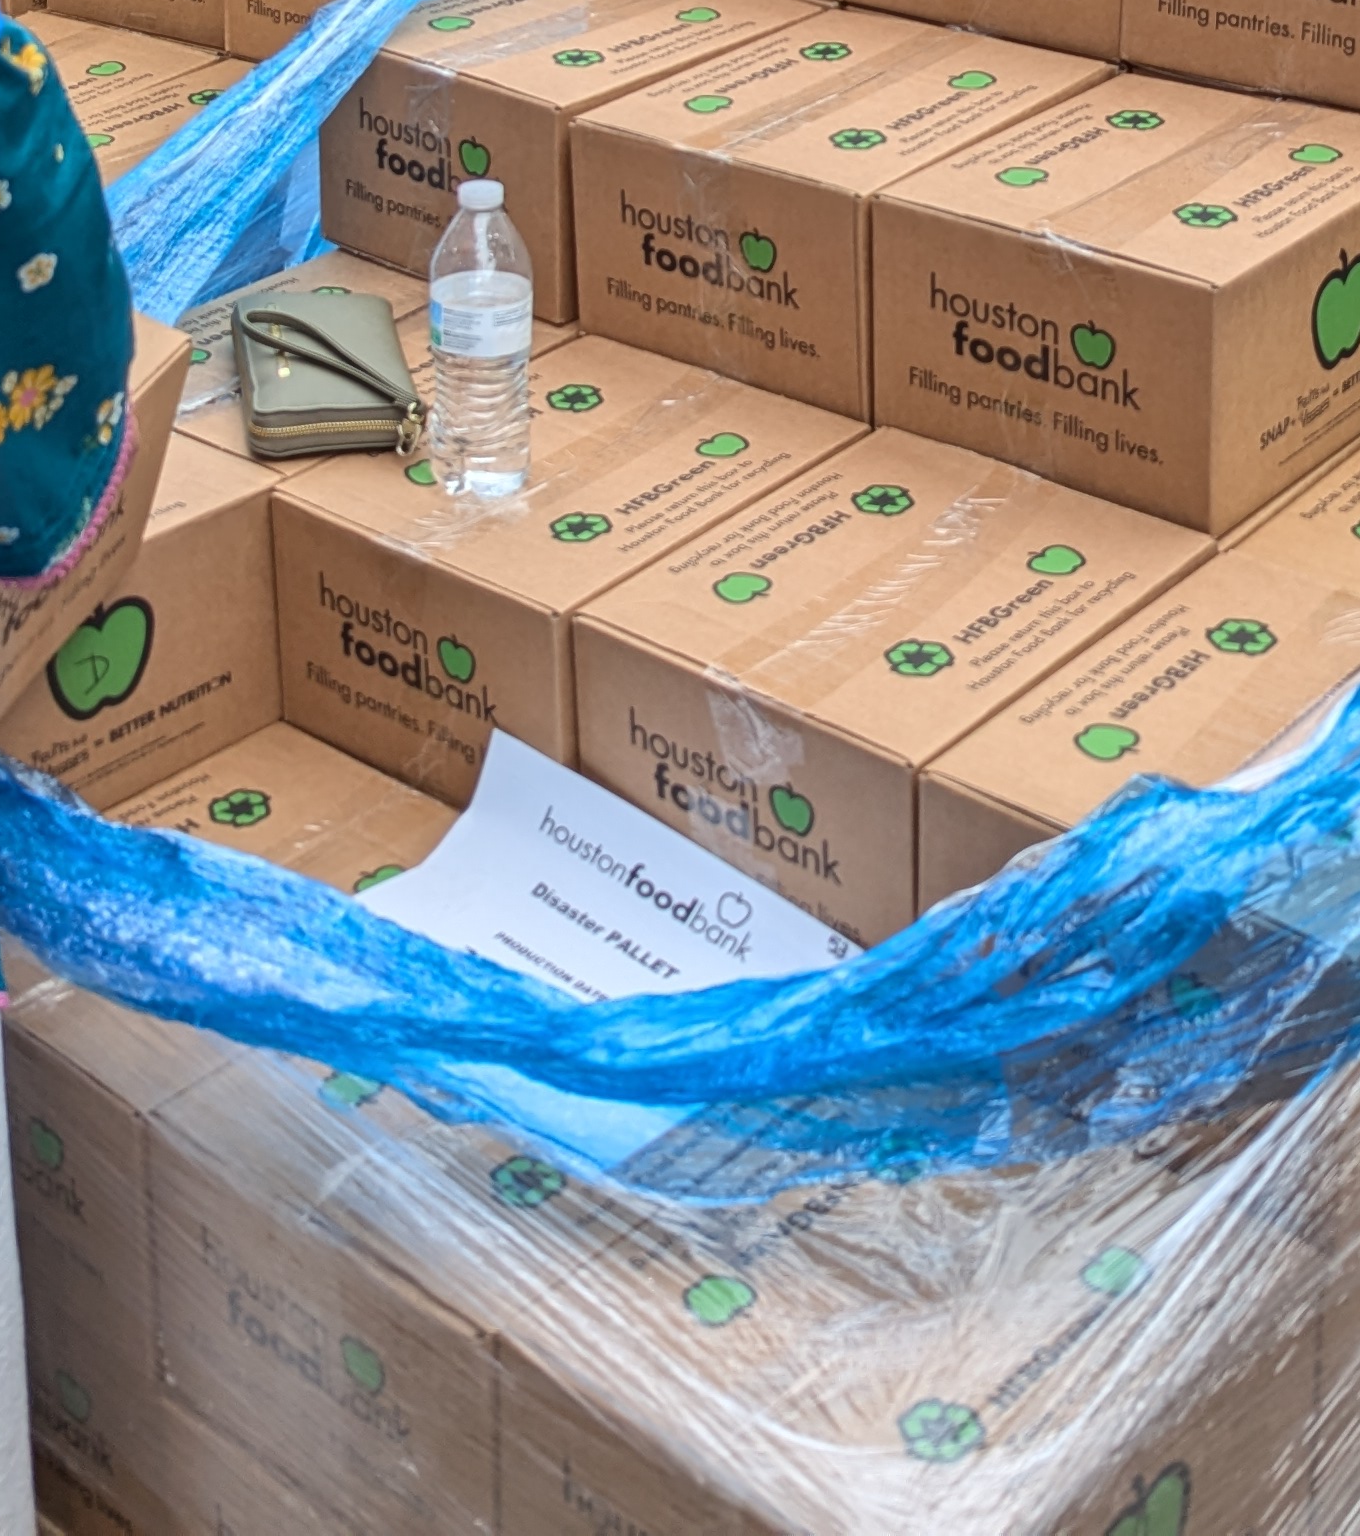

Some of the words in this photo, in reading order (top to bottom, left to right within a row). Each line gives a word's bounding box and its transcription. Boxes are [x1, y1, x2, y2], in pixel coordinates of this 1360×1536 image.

[1215, 11, 1295, 39] pantries.
[1301, 20, 1356, 57] Filling
[359, 97, 452, 159] houston
[345, 178, 383, 213] Filling
[376, 138, 461, 194] foodb
[620, 188, 730, 253] houston
[641, 232, 800, 311] foodbank
[607, 276, 652, 313] Filling
[656, 297, 724, 330] pantries.
[728, 312, 776, 351] Filling
[779, 326, 820, 359] lives.
[930, 271, 1059, 346] houston
[952, 320, 1140, 412] foodbank
[909, 365, 961, 406] Filling
[967, 390, 1047, 428] pantries.
[1053, 410, 1109, 454] Filling
[1114, 428, 1163, 466] lives.
[615, 460, 717, 516] HFBGreen
[749, 510, 852, 570] HFBGreen
[318, 571, 428, 656] houston
[952, 579, 1054, 645] HFBGreen
[306, 661, 351, 705] Filling
[340, 621, 499, 728] foodbank
[1109, 650, 1212, 721] HFBGreen
[109, 710, 157, 744] BETTER
[629, 707, 758, 805] houston
[653, 762, 842, 887] foodbank
[531, 880, 605, 935] Disaster
[604, 929, 681, 981] PALLET
